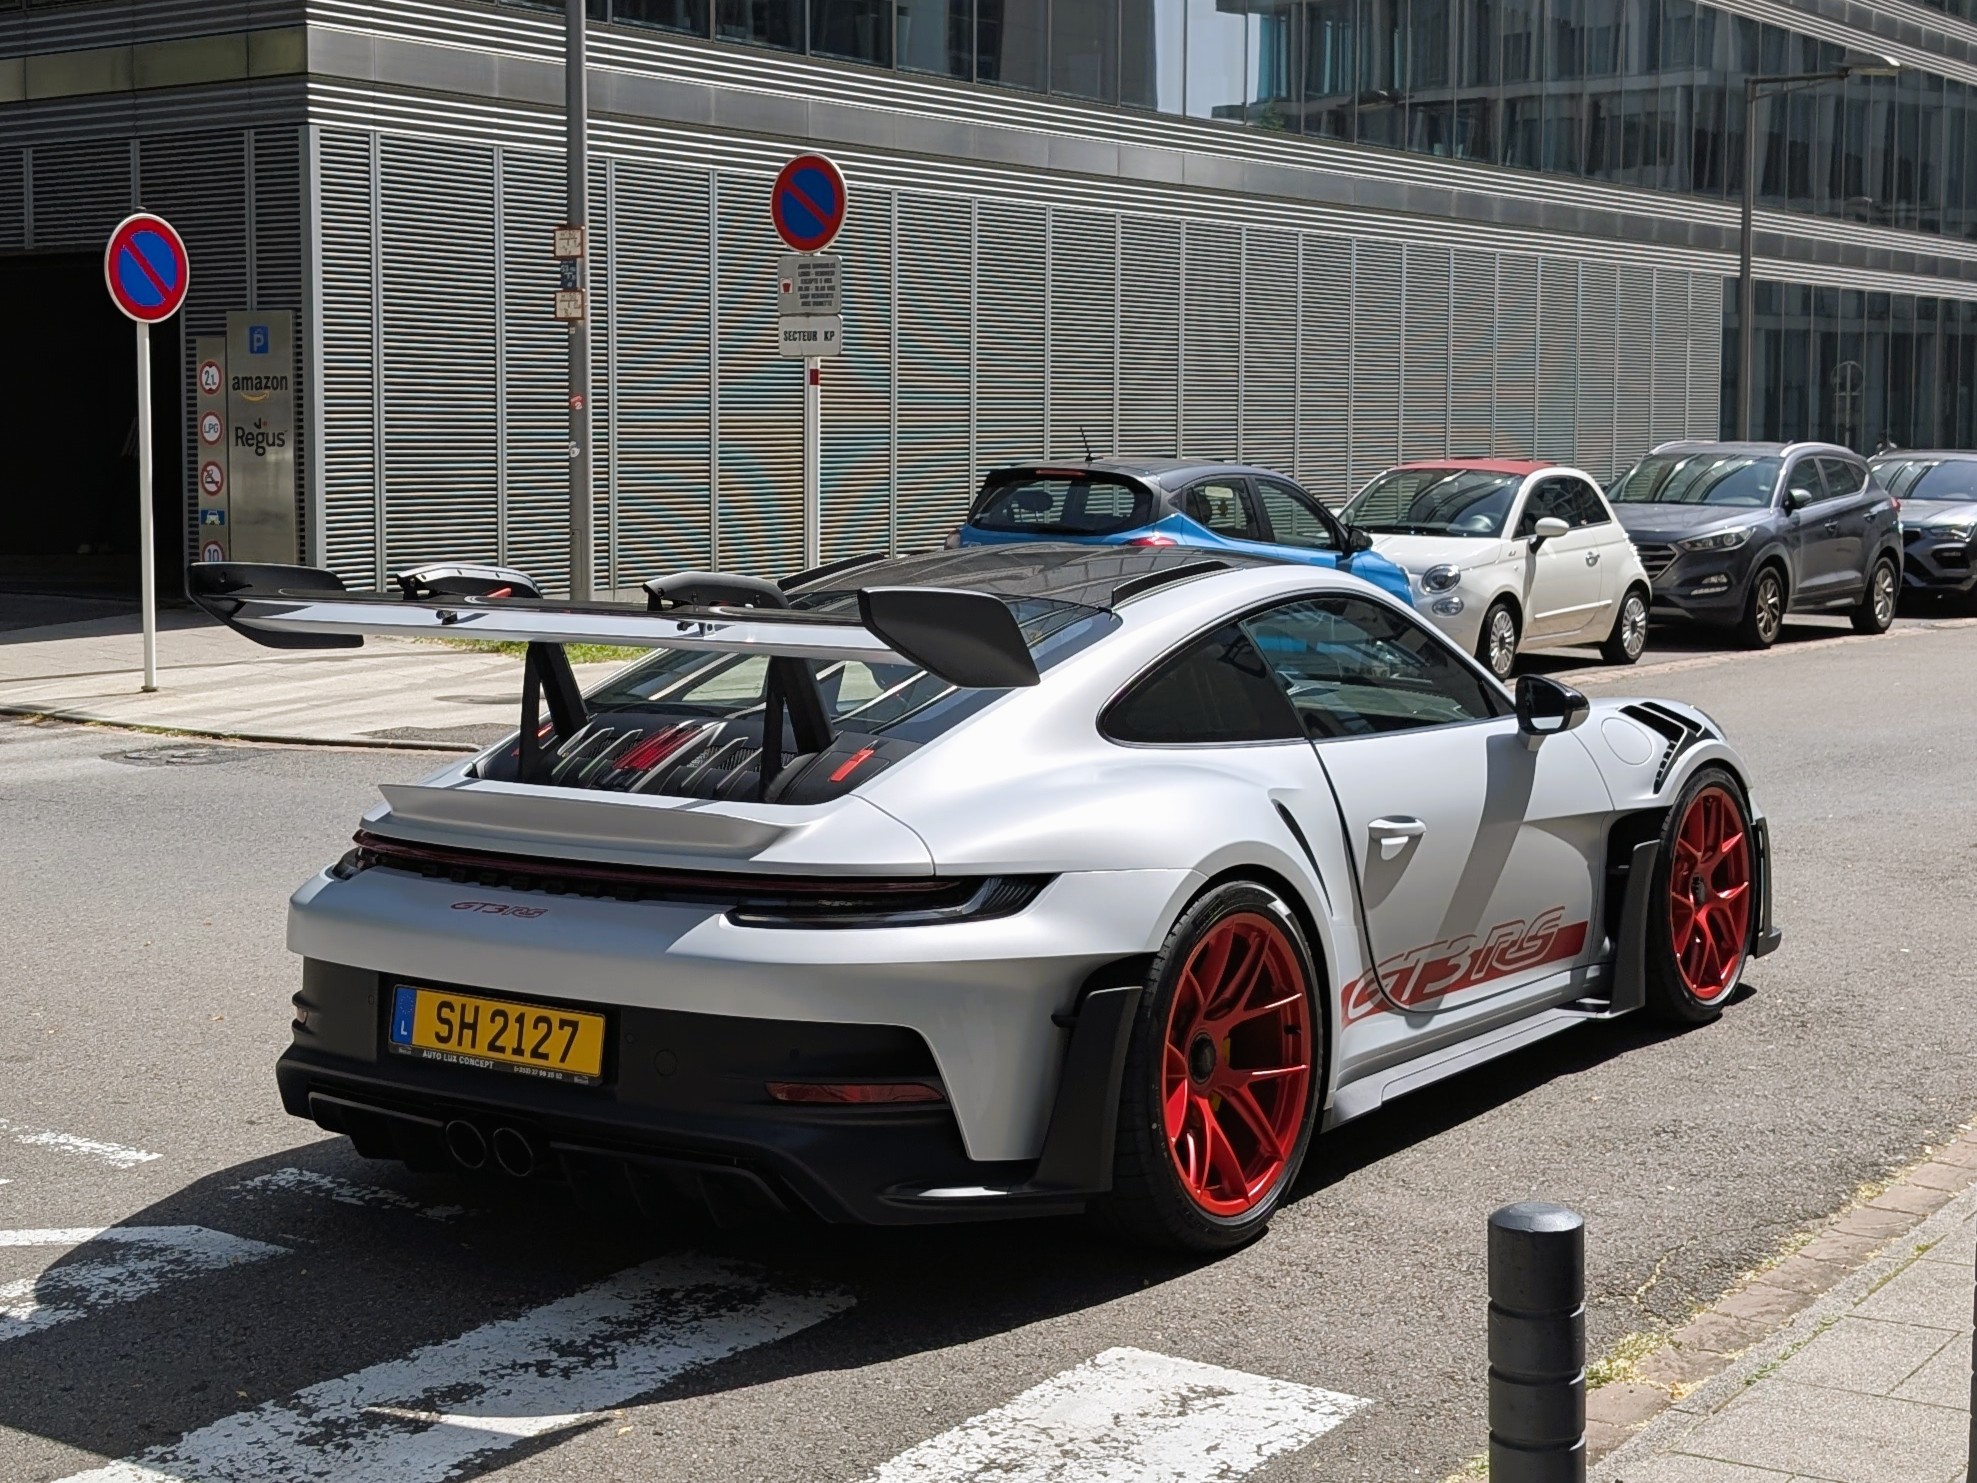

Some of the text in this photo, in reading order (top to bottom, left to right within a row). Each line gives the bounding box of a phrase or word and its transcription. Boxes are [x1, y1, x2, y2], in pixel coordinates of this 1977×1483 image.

[783, 330, 835, 342] SECTEUR KP
[231, 375, 288, 391] amazon
[203, 423, 219, 434] LPG
[234, 425, 286, 457] Regus
[207, 549, 219, 561] 10
[400, 1020, 408, 1036] L
[434, 1000, 580, 1064] SH 2127
[422, 1049, 442, 1060] AUTO
[443, 1053, 458, 1063] LUX
[458, 1056, 495, 1070] CONCEPT
